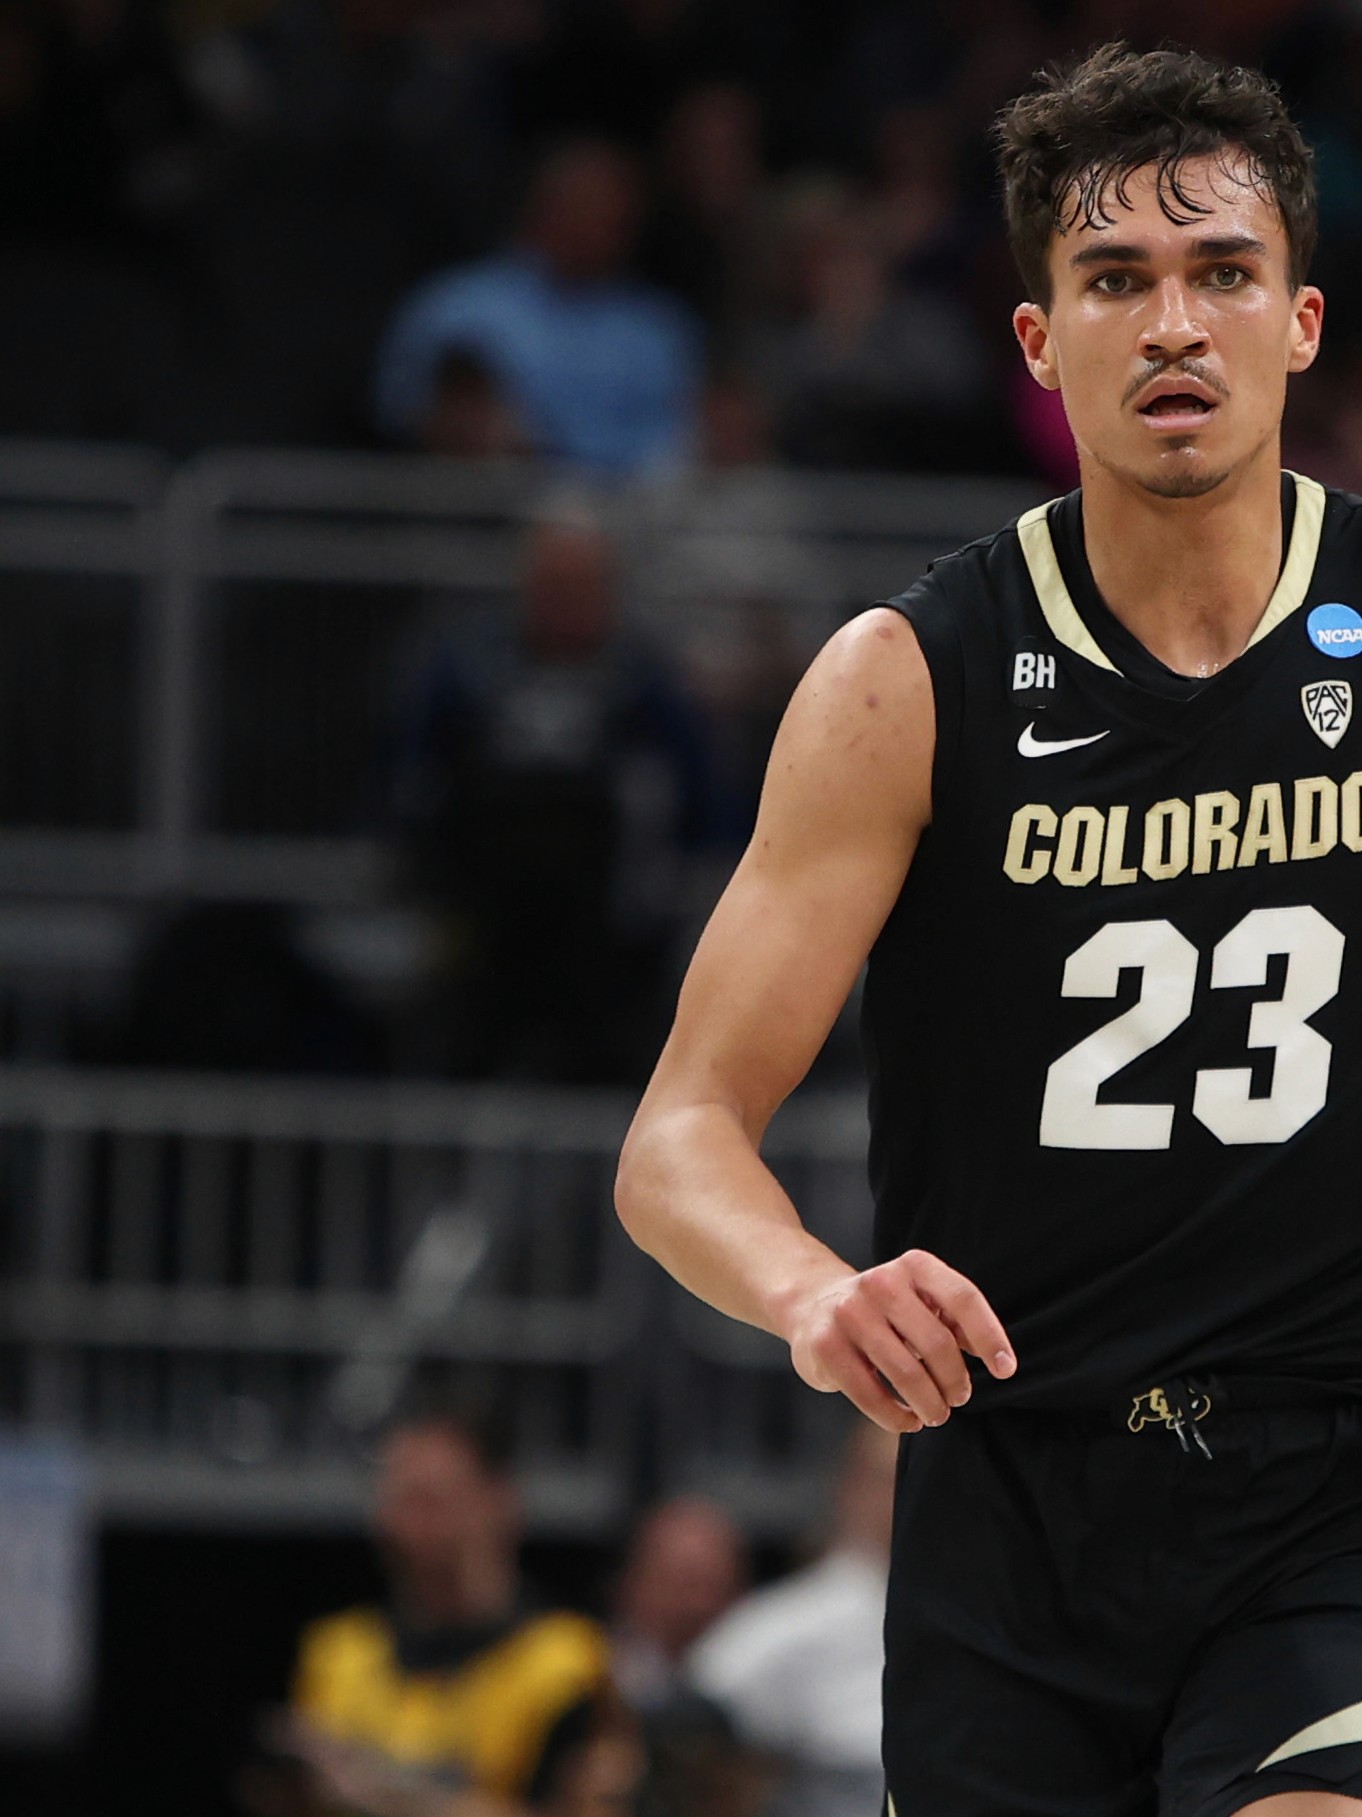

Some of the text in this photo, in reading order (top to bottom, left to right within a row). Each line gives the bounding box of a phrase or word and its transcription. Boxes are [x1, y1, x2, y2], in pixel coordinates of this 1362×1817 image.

[1012, 652, 1056, 691] BH
[1306, 685, 1348, 720] PAC
[1317, 709, 1341, 733] 12
[1039, 904, 1347, 1150] 23
